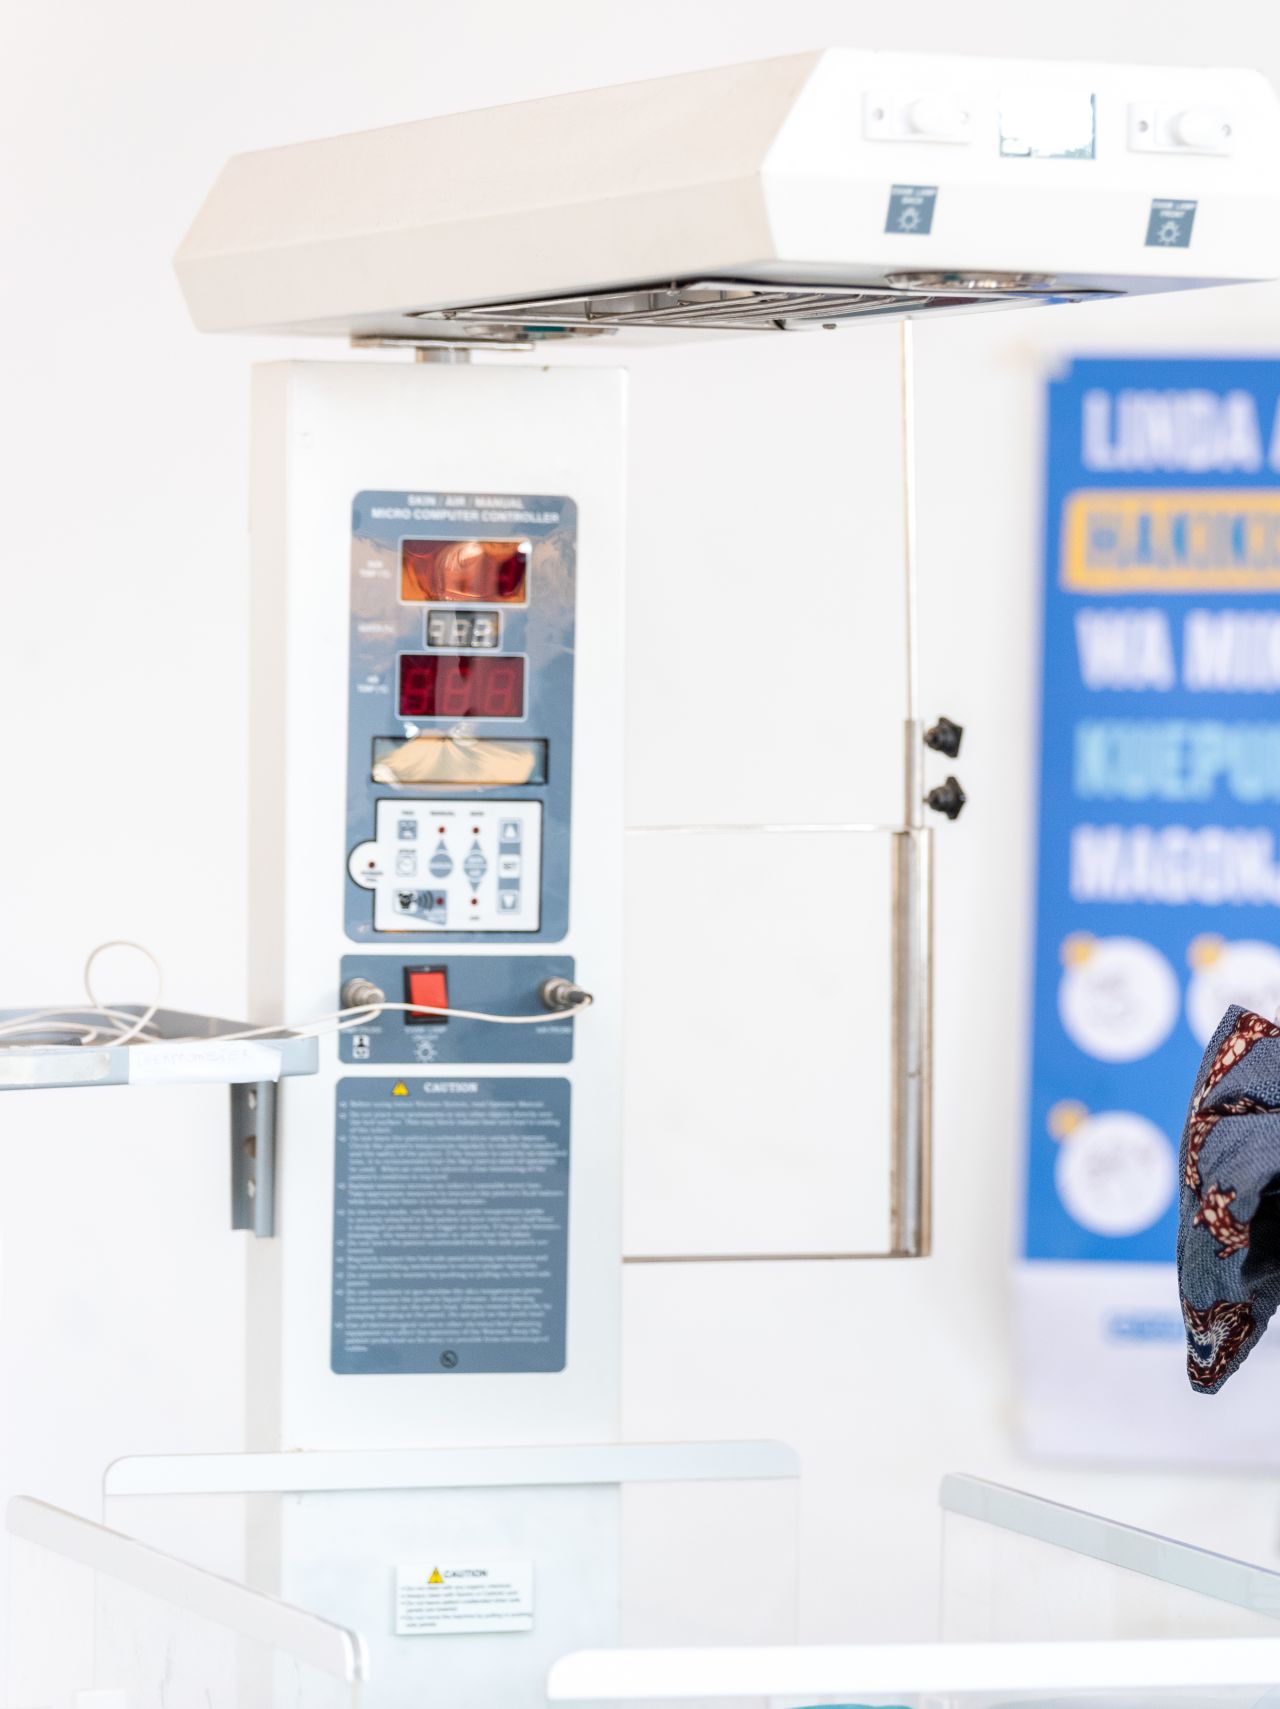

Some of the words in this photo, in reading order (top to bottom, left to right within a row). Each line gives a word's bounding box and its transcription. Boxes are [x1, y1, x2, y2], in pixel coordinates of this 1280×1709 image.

[1083, 390, 1262, 473] LINDA
[407, 495, 436, 506] SKIN
[445, 496, 465, 507] AIR
[474, 497, 524, 509] MANUAL
[371, 507, 411, 519] MICRO
[413, 508, 478, 521] COMPUTER
[481, 510, 560, 523] CONTROLLER
[1076, 609, 1175, 692] WA
[423, 1082, 478, 1093] CAUTION
[444, 1569, 487, 1579] CAUTION
